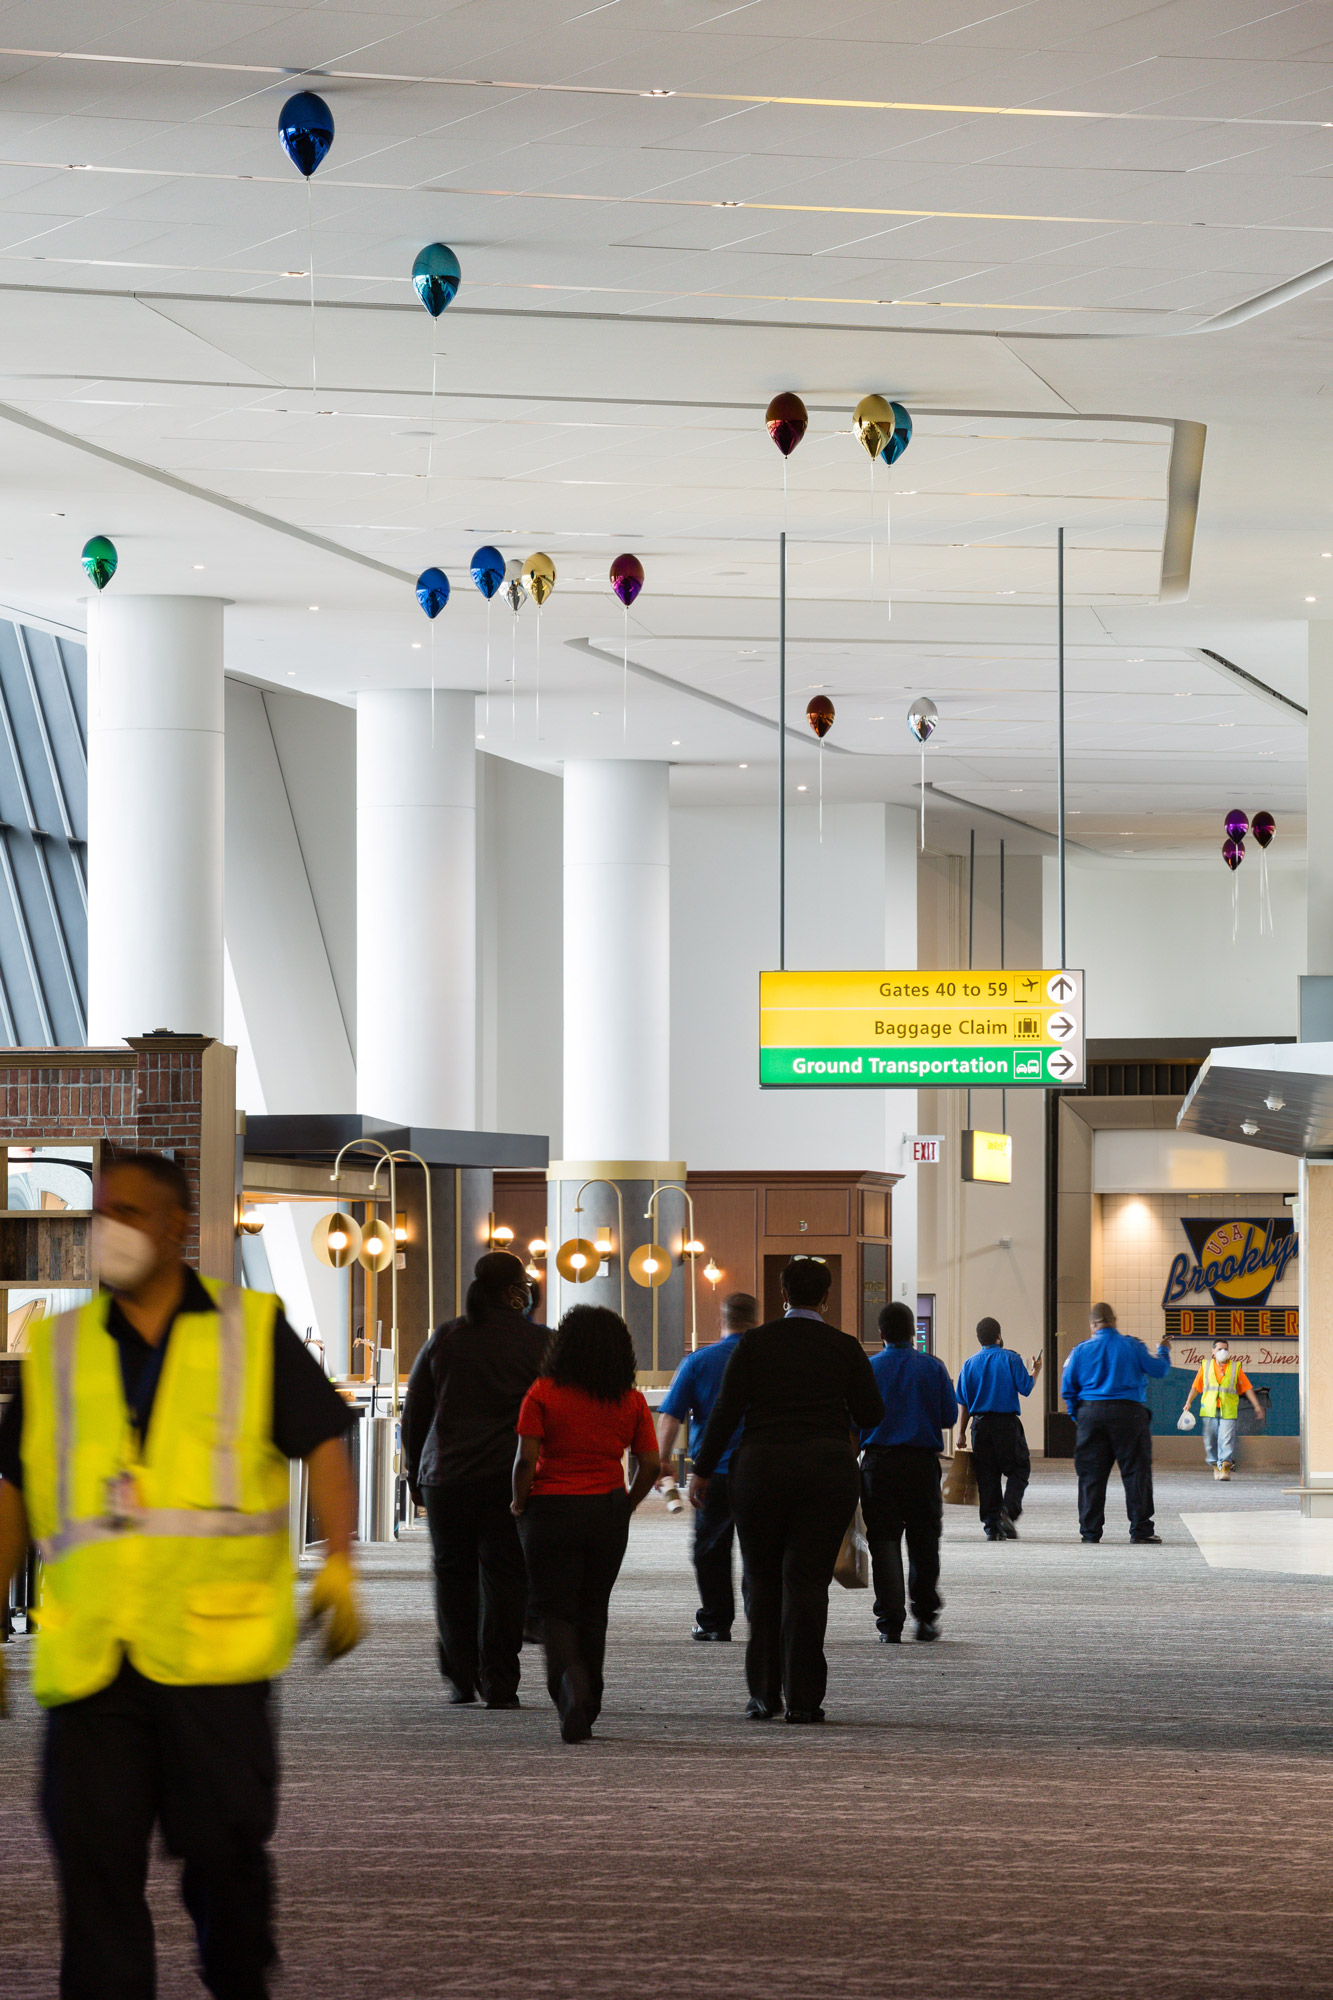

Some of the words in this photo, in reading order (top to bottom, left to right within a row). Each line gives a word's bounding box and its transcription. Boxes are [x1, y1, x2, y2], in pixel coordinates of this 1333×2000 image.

[879, 982, 929, 996] Gates
[936, 982, 956, 996] 40
[963, 983, 981, 996] to
[988, 982, 1008, 996] 59
[874, 1020, 952, 1038] Baggage
[959, 1020, 1008, 1035] Claim
[792, 1057, 863, 1074] Ground
[868, 1057, 1008, 1077] Transportation
[913, 1142, 936, 1160] EXIT
[1205, 1223, 1245, 1256] USA
[1181, 1310, 1299, 1336] DINER
[1181, 1347, 1205, 1364] The
